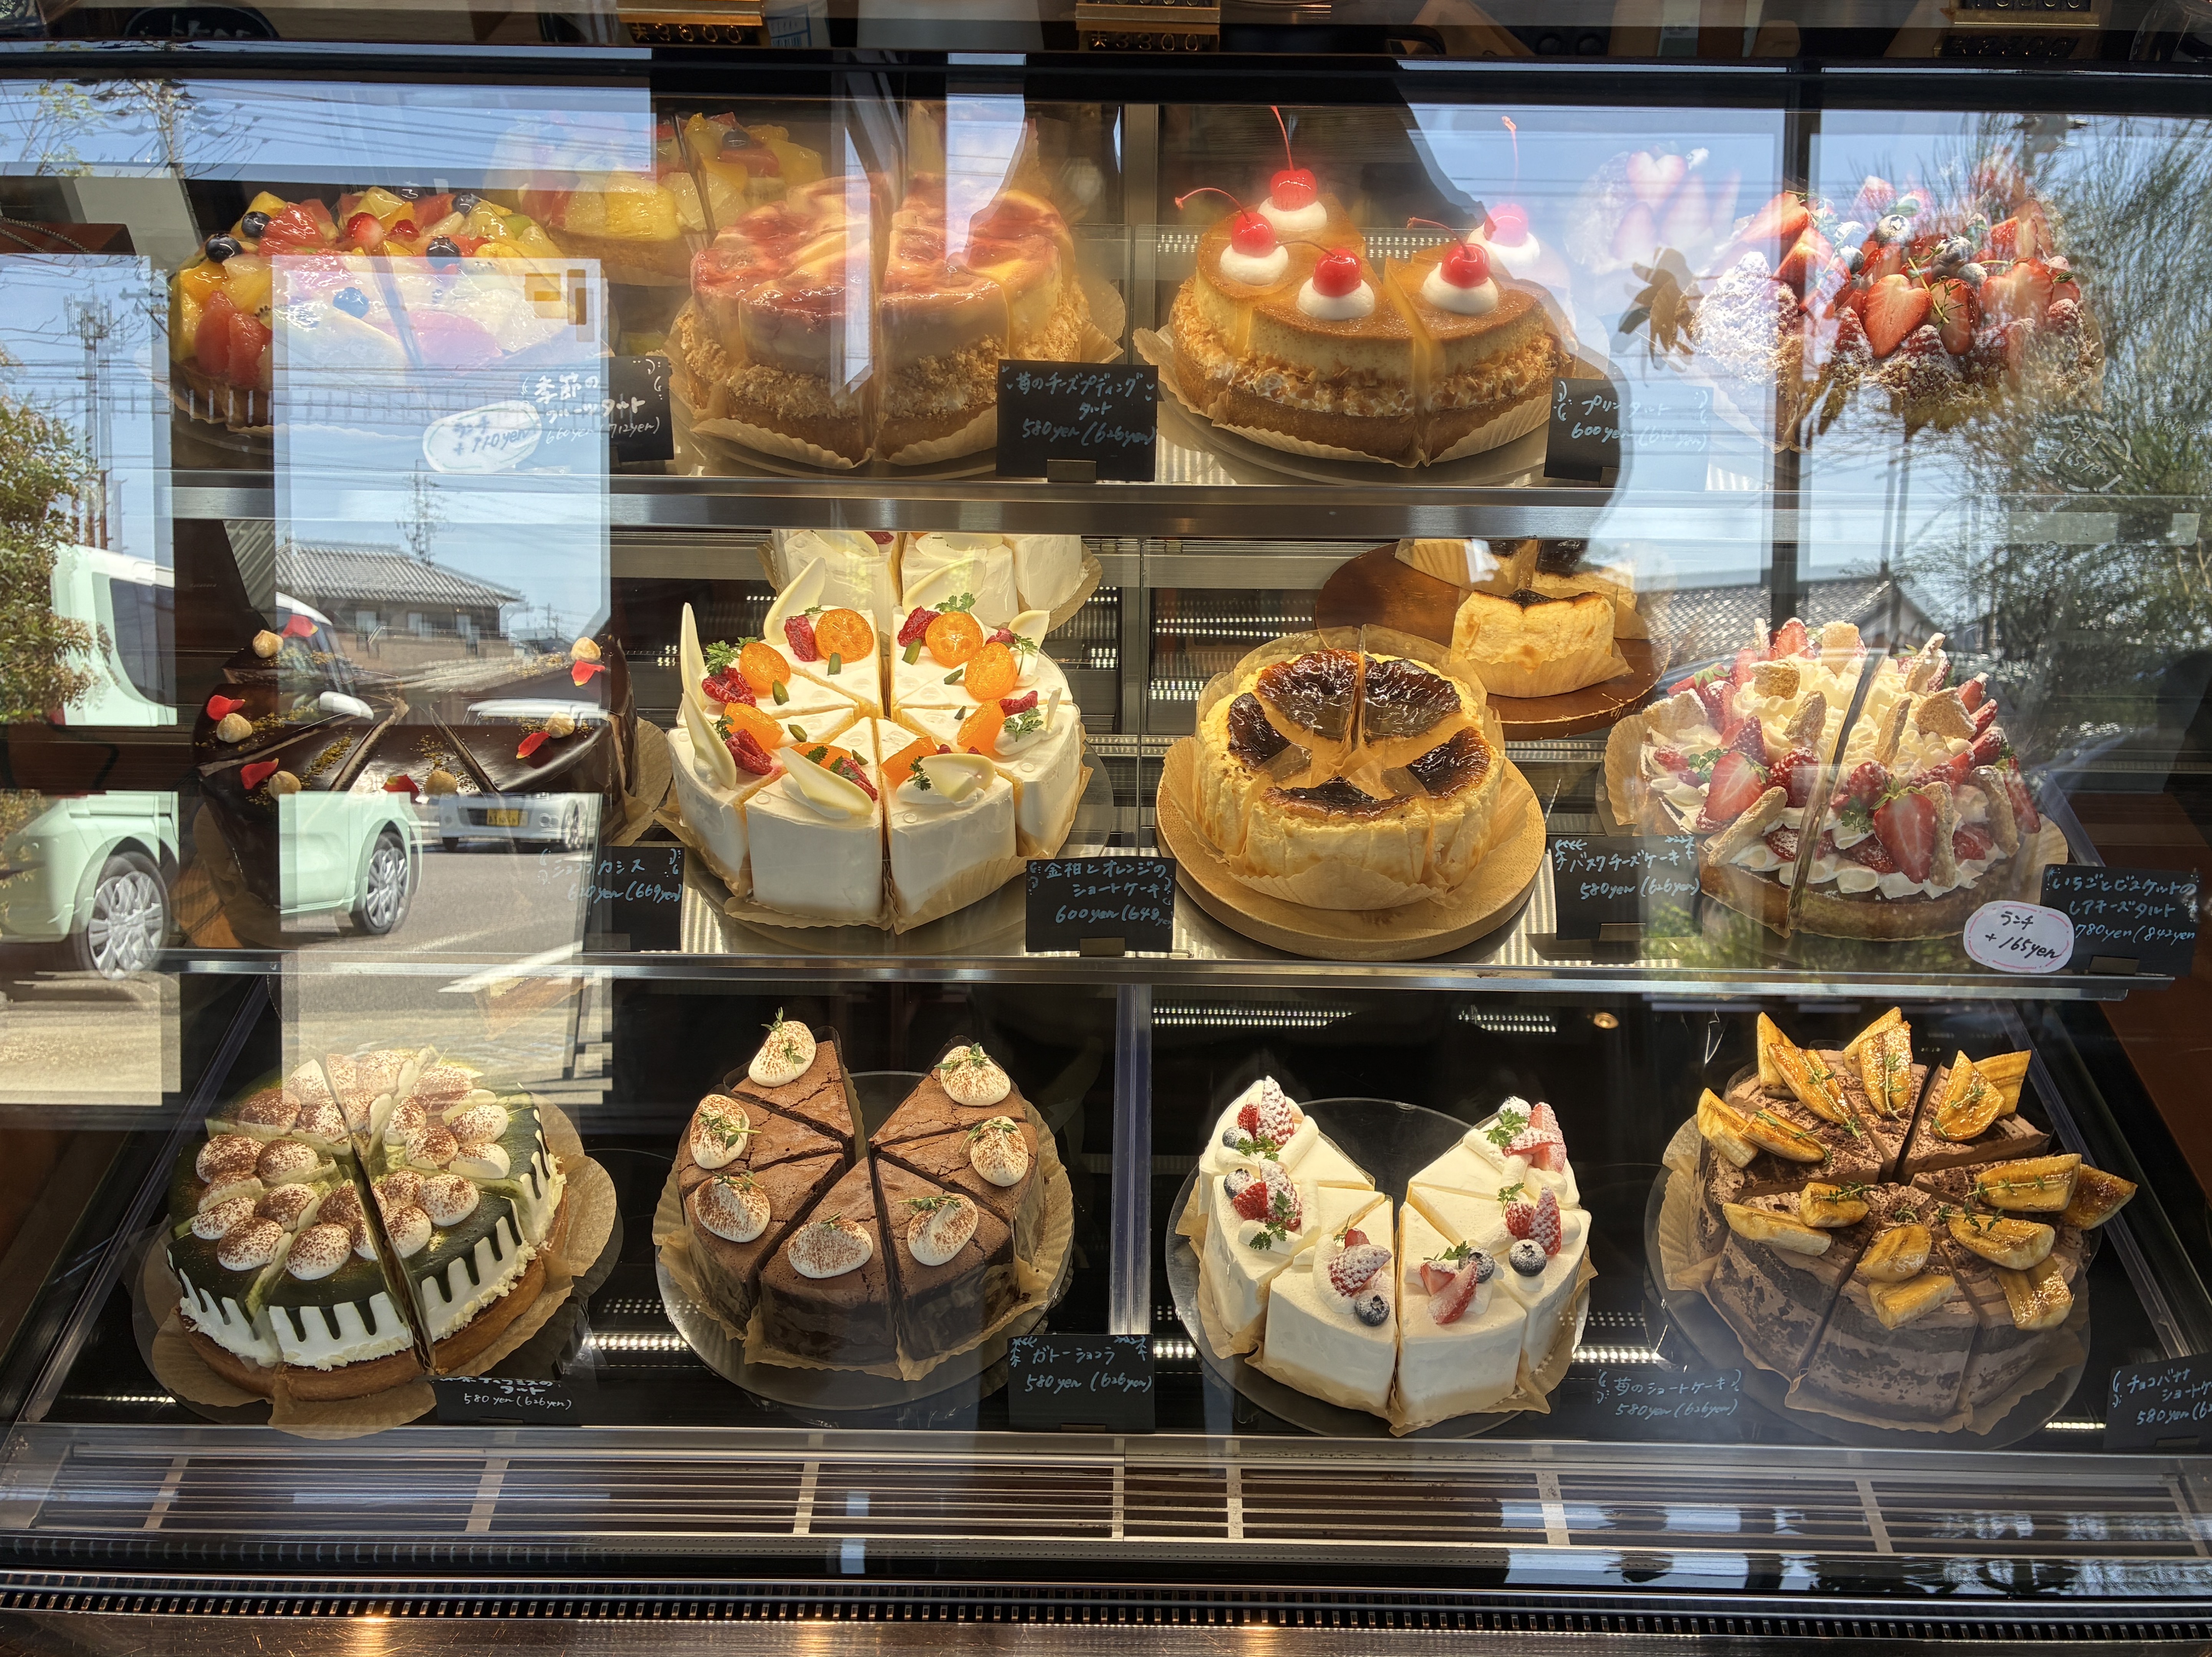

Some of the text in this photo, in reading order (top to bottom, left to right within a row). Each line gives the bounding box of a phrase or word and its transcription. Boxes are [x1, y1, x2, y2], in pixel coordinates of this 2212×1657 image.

[534, 371, 599, 404] 季節の
[1569, 849, 1680, 873] バスクチーズケーキ
[1073, 882, 1160, 898] ショートケーキ
[1056, 905, 1119, 923] 600yen
[2069, 900, 2176, 919] レアチーズタルト
[2001, 911, 2034, 930] ランチ
[2075, 923, 2132, 942] 780yen
[1985, 933, 2063, 959] + 165yen
[1032, 1345, 1115, 1365] ガトーショコラ
[1614, 1377, 1726, 1396] 苺のショートケーキ
[2127, 1368, 2190, 1394] チョコバナナ
